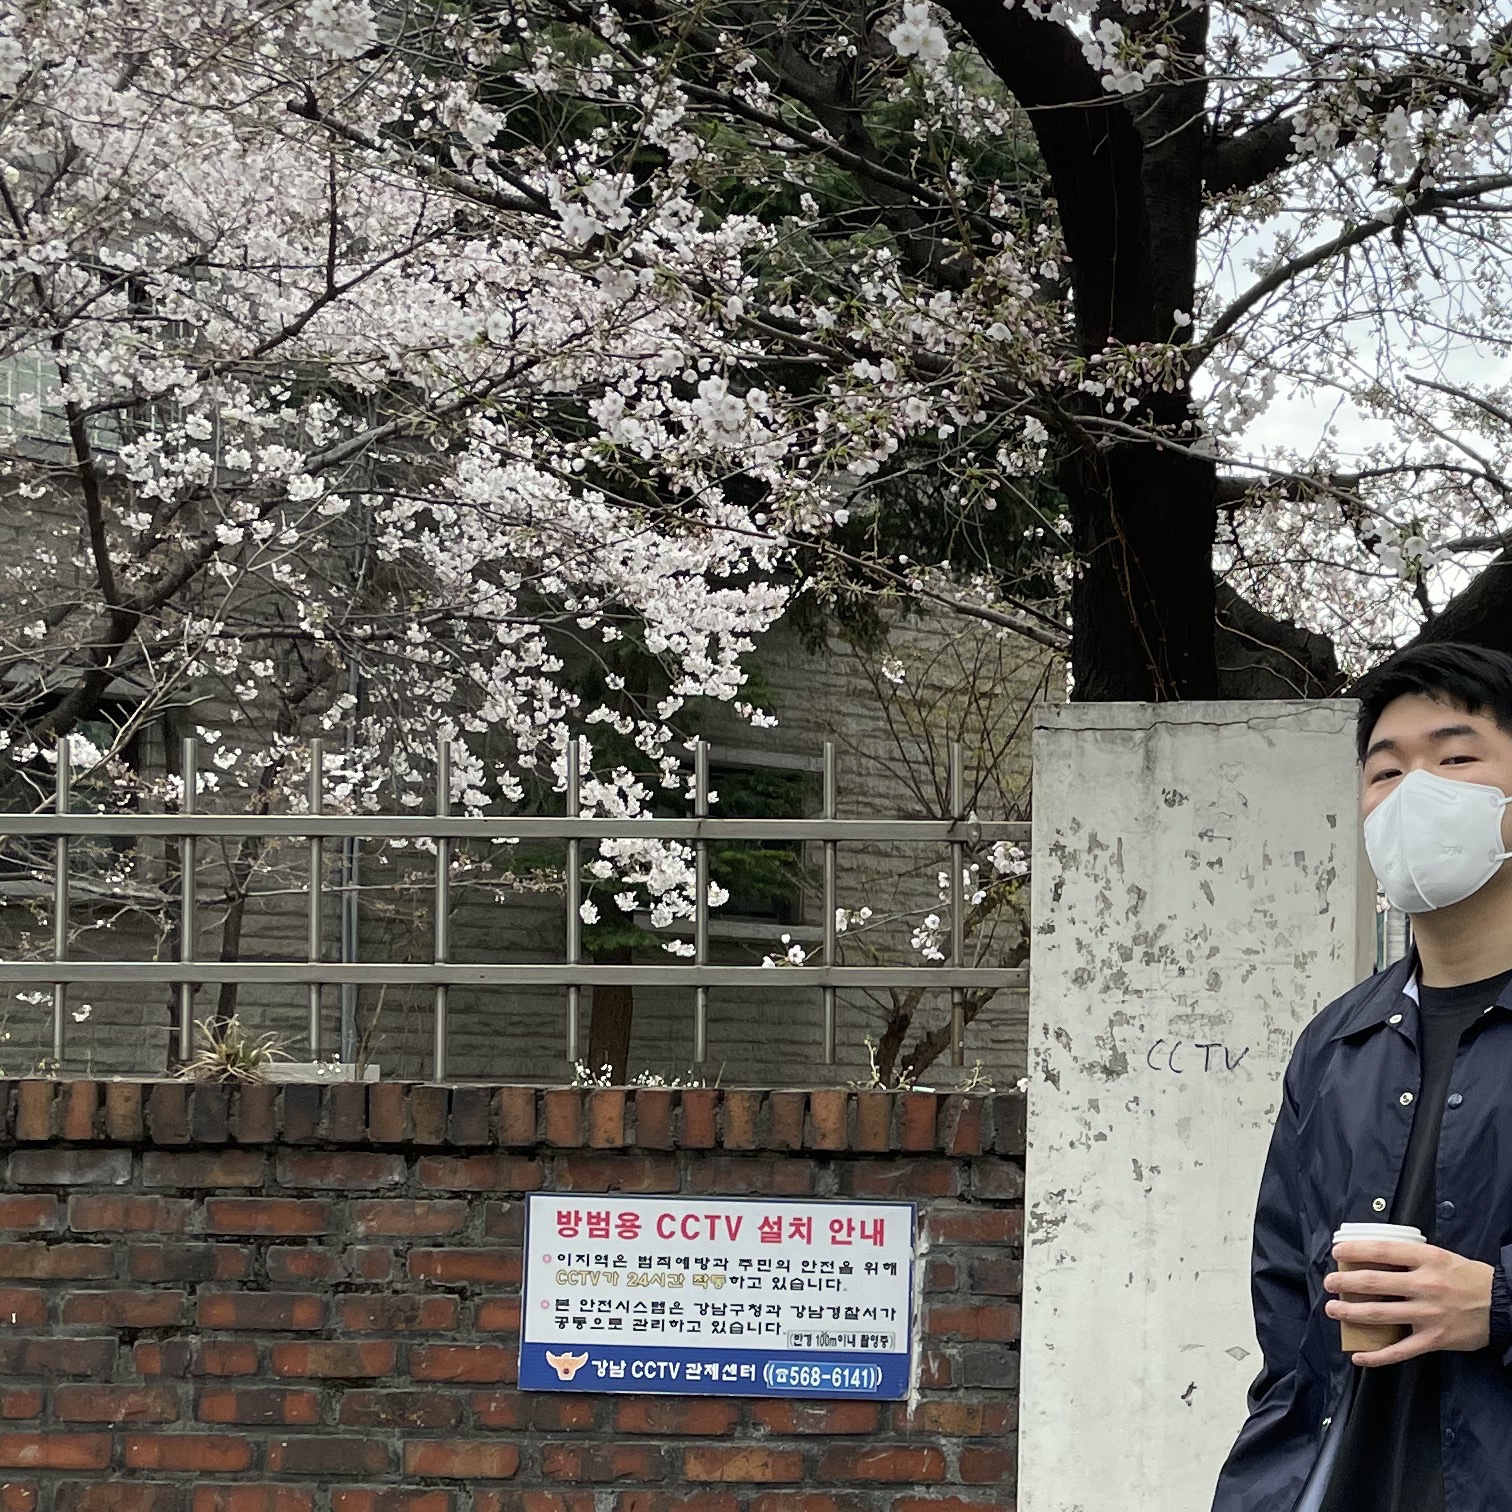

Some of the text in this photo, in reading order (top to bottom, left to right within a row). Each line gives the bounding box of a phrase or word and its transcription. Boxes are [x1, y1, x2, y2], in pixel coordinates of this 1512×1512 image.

[1147, 1039, 1249, 1073] CCTV
[556, 1210, 885, 1247] 방범용 CCTV 설치 안내
[557, 1253, 628, 1269] 이지역은
[738, 1258, 791, 1273] 주민의
[801, 1260, 854, 1275] 안전을
[864, 1261, 898, 1276] 위해
[555, 1269, 620, 1286] CCTV가
[626, 1271, 685, 1289] 24시간
[772, 1276, 847, 1292] 있습니다.
[580, 1299, 684, 1315] 안전시스템은
[693, 1302, 782, 1318] 강남구청과
[790, 1305, 897, 1321] 강남경찰서가
[555, 1316, 787, 1336] 공동으로 관리하고 있습니다.
[591, 1359, 627, 1378] 강남
[631, 1360, 681, 1380] CCTV
[685, 1362, 756, 1382] 관제센터
